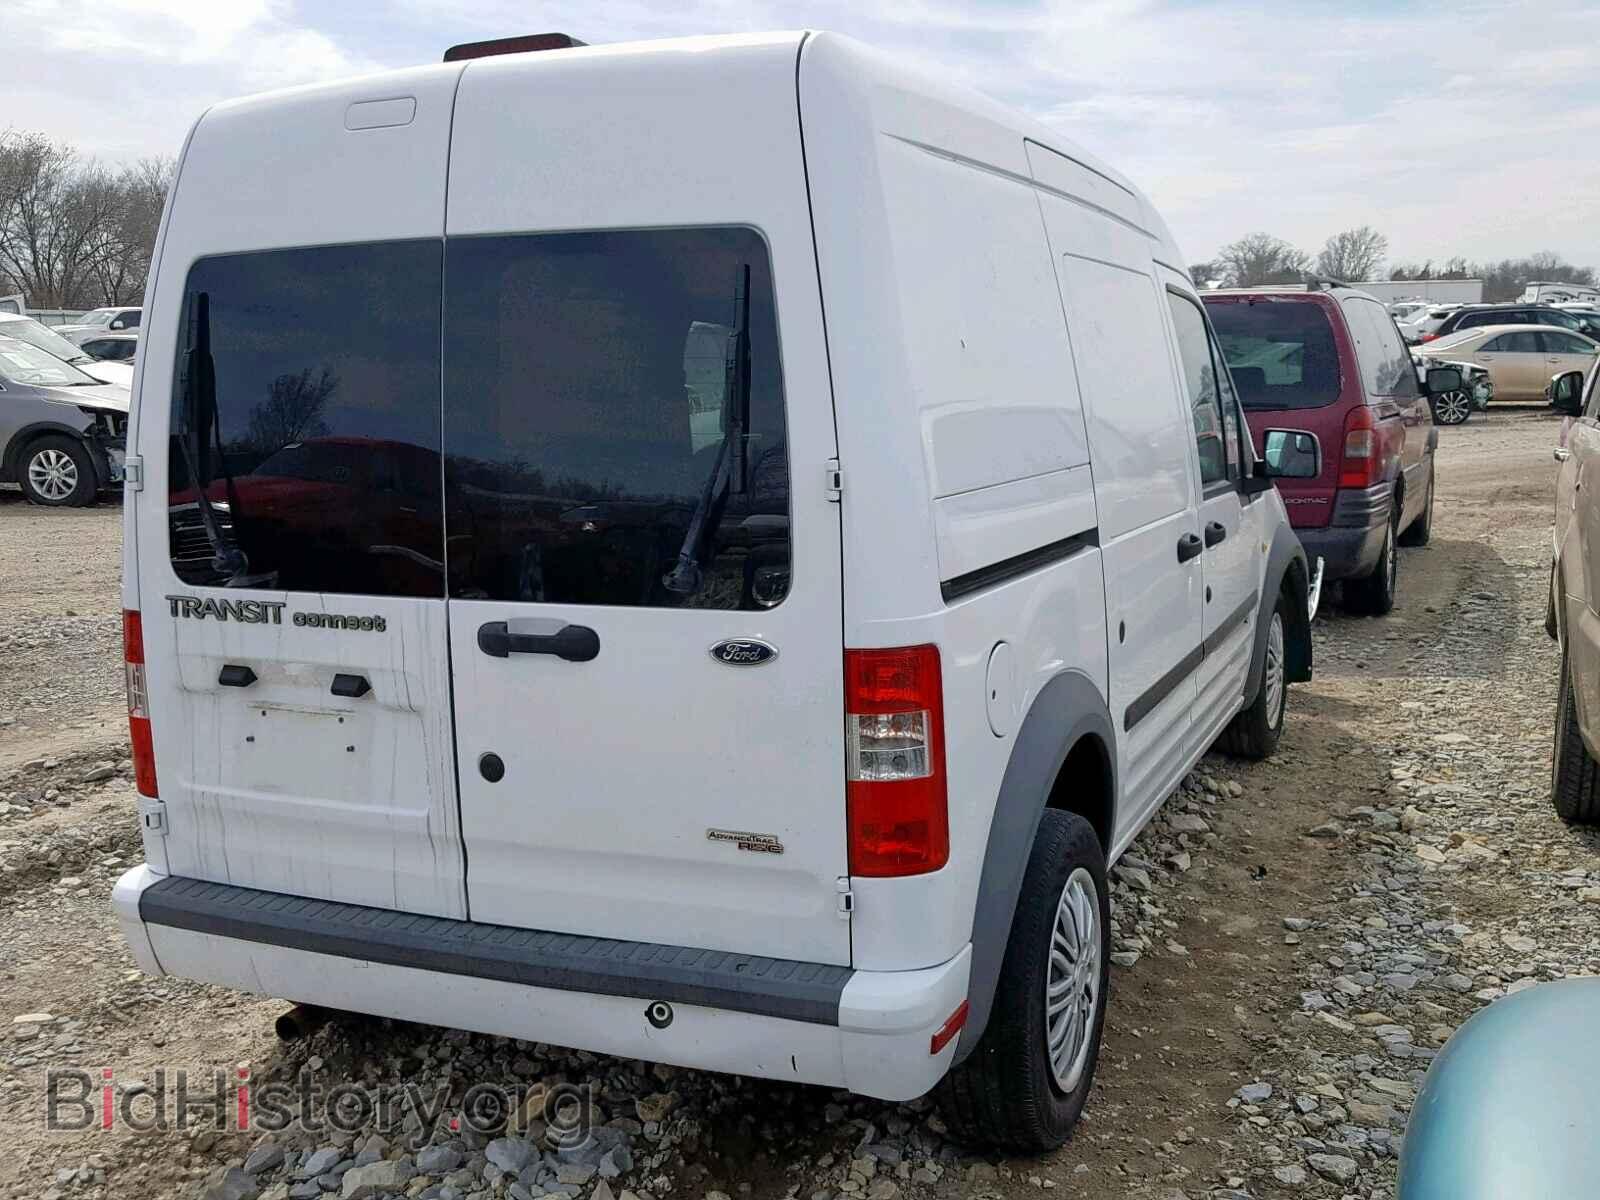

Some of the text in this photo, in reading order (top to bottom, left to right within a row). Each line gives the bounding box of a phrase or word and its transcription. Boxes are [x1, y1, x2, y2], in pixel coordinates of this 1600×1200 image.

[165, 595, 387, 632] TRANSIT connect
[723, 643, 761, 661] Ford
